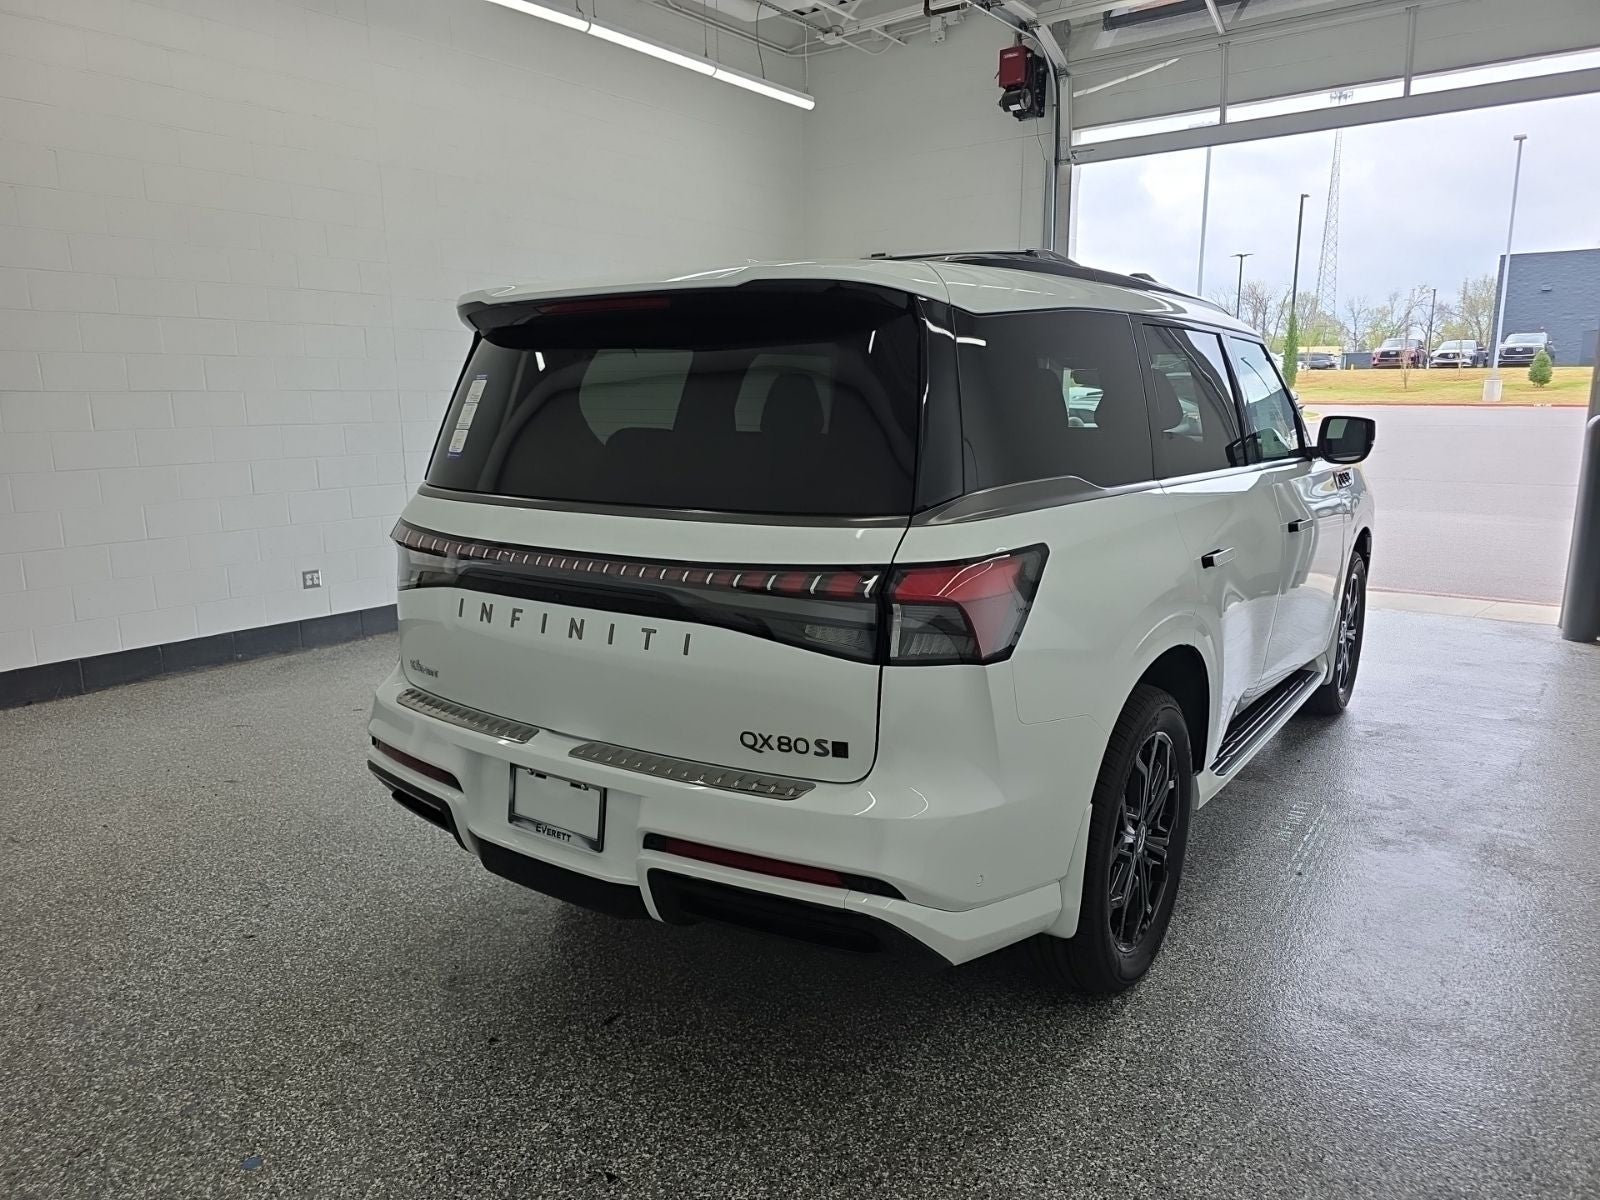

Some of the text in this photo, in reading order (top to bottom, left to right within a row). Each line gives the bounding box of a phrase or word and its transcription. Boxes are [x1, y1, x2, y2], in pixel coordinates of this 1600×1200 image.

[457, 597, 692, 656] INFINITI
[739, 730, 810, 755] QX80
[535, 823, 572, 843] EVERETT
